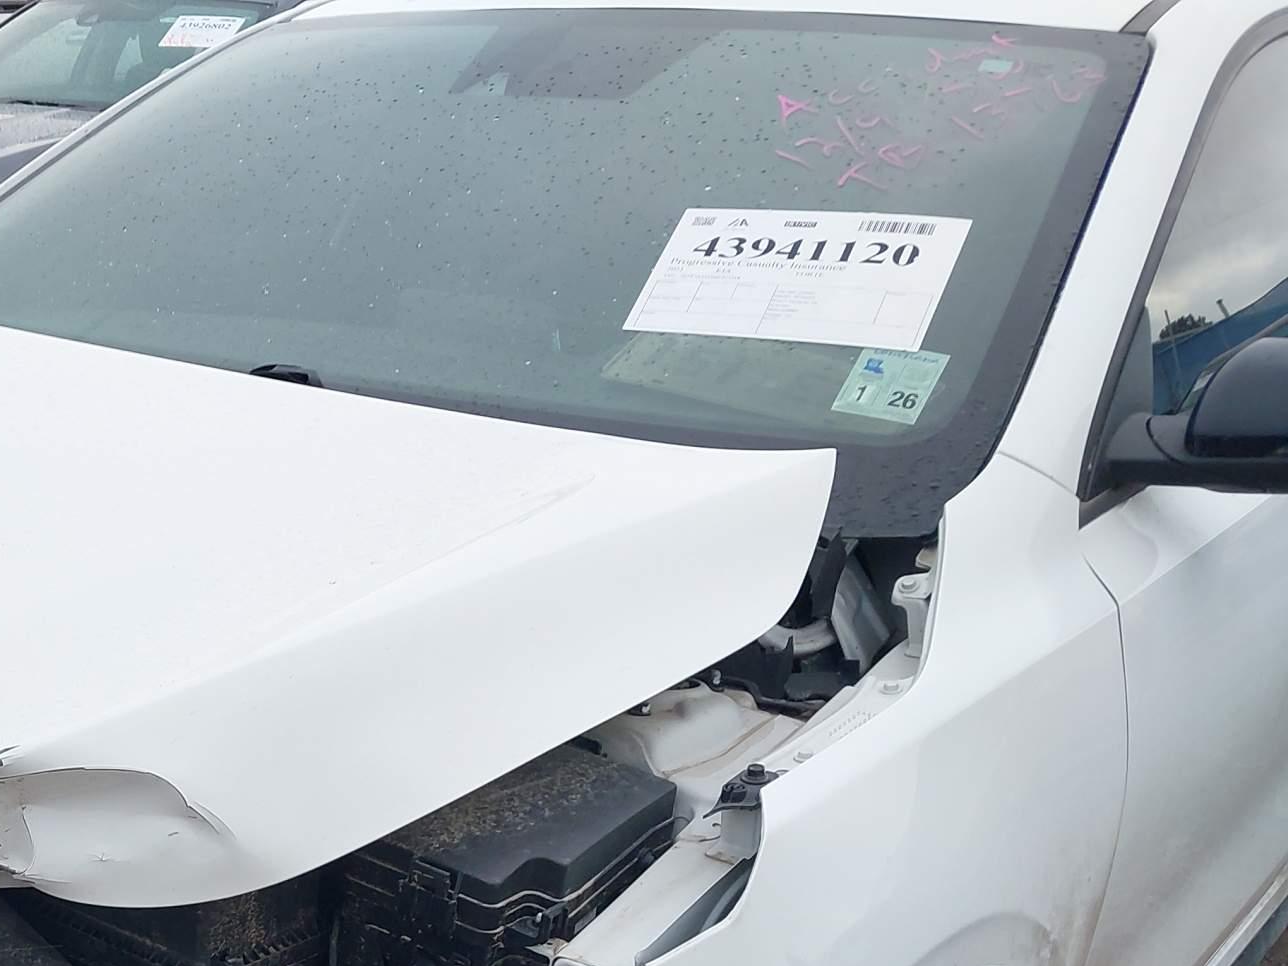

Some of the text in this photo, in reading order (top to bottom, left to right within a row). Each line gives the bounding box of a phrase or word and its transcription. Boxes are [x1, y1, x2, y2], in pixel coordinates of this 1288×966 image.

[693, 236, 920, 266] 43941120
[671, 257, 847, 271] Progressive Casualty Insurance
[855, 384, 918, 409] 1 26
